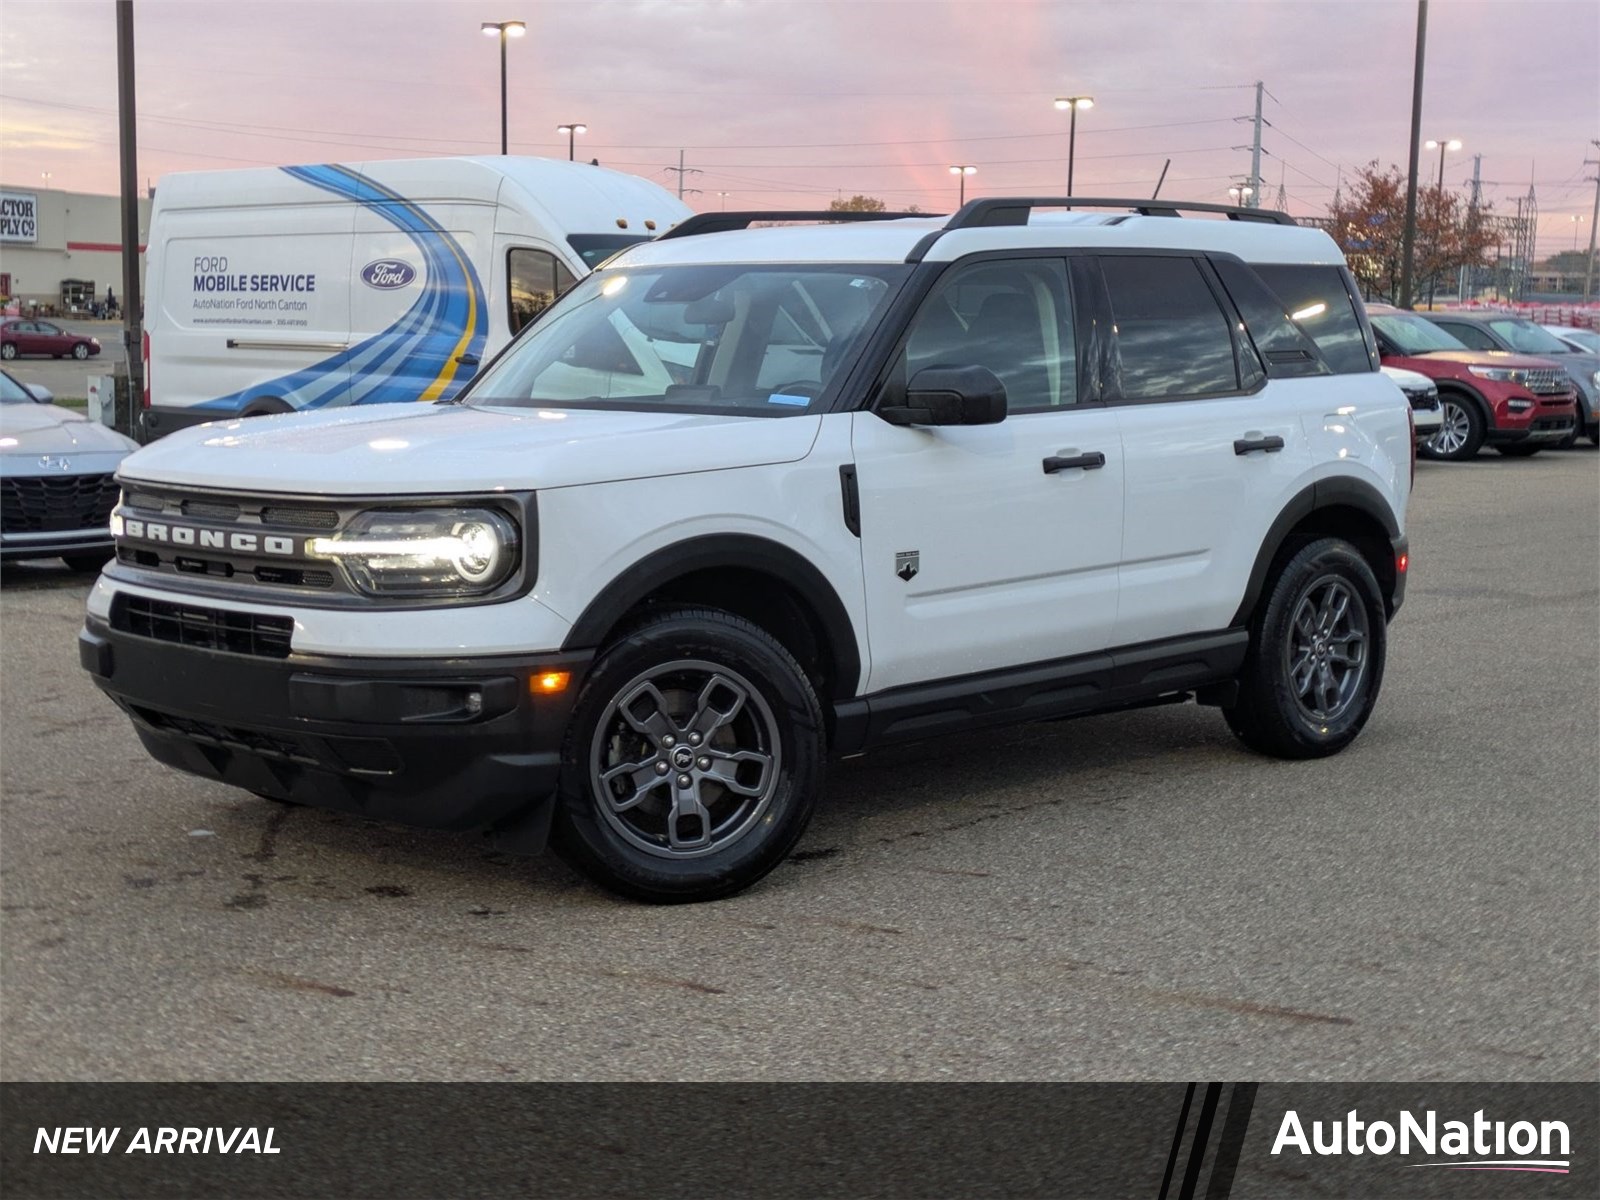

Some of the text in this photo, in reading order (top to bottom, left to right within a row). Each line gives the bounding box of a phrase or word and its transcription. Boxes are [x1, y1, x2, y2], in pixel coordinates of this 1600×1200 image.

[0, 199, 34, 217] CTOR
[194, 256, 228, 273] FORD
[371, 263, 405, 284] Ford
[193, 275, 315, 292] MOBILE SERVICE
[193, 298, 308, 311] AutoNation Ford North Canton
[125, 518, 294, 555] BRONCO
